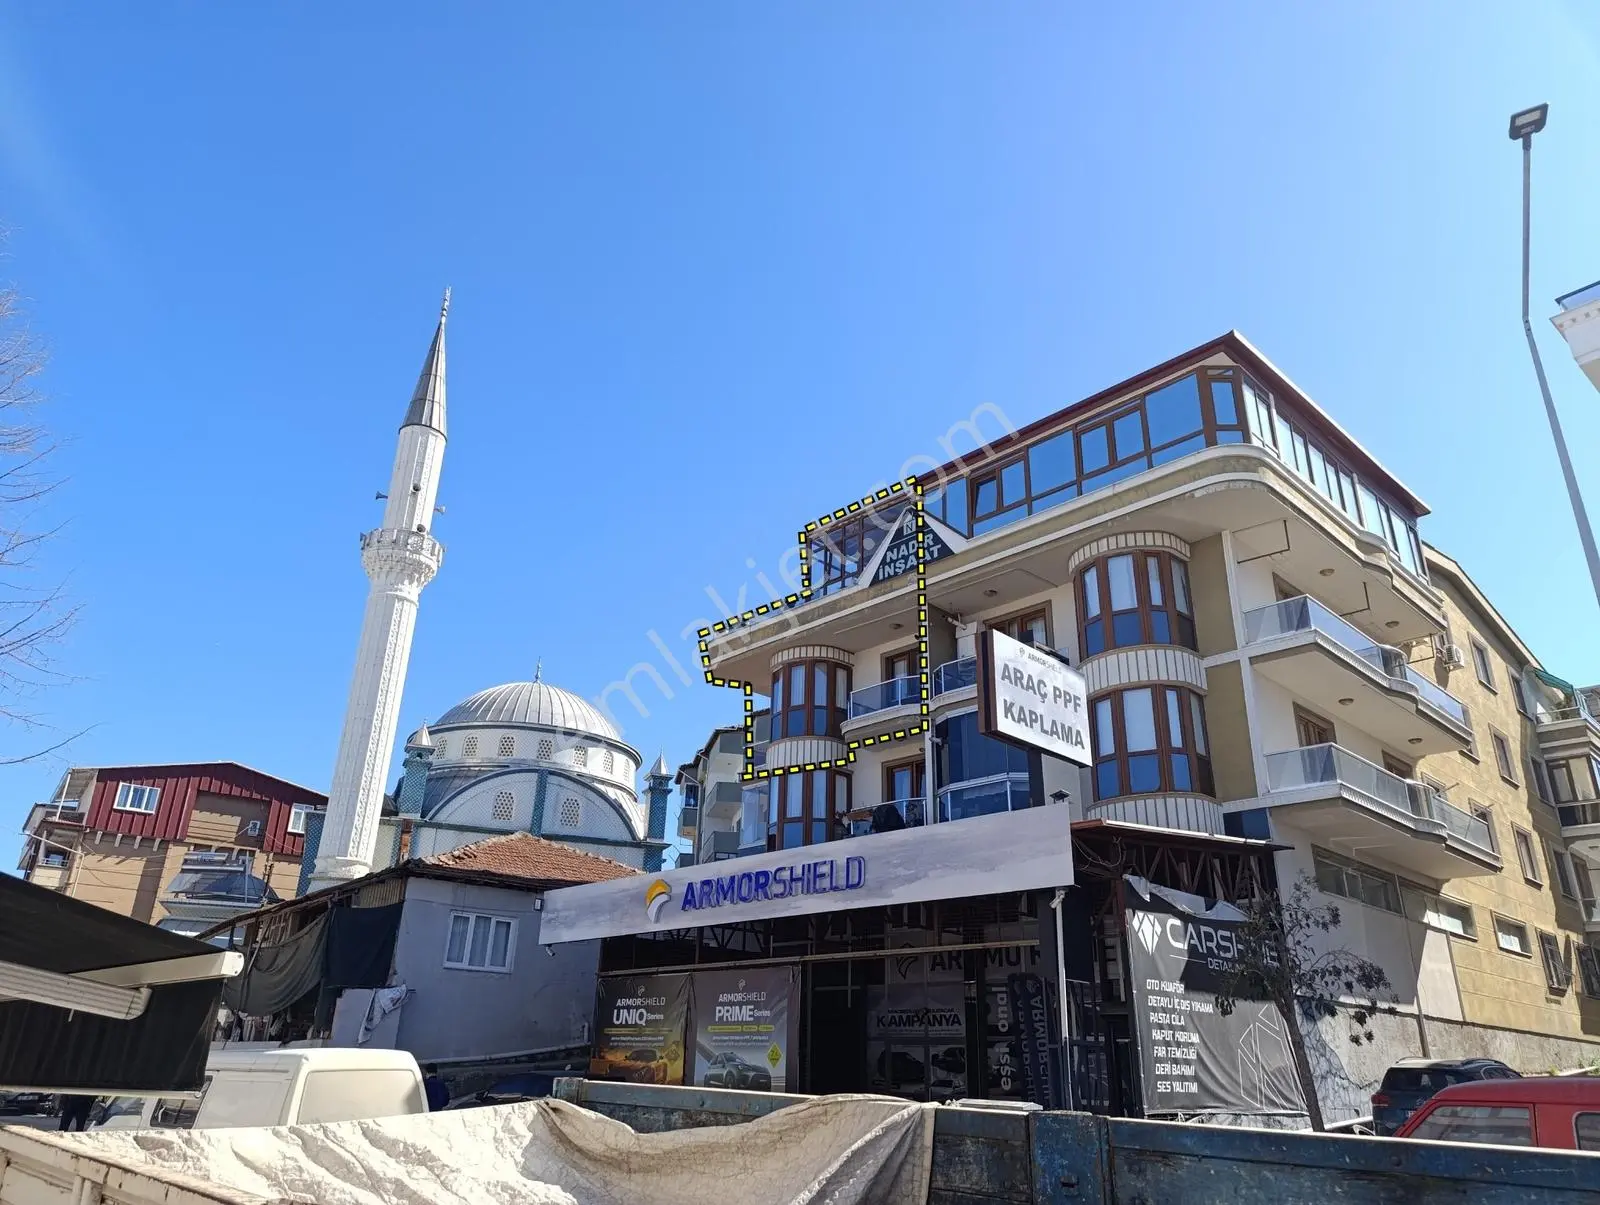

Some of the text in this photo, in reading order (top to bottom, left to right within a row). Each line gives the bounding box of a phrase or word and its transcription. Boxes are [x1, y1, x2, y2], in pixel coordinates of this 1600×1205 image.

[886, 533, 935, 563] NADR
[1001, 663, 1081, 713] ARAÇ PPF
[1003, 698, 1085, 750] KAPLAMA
[681, 855, 866, 912] ARMORSHIELD
[1166, 918, 1279, 968] CARSHE
[1146, 979, 1160, 990] OTO
[616, 997, 666, 1007] ARMORSHIELD
[718, 991, 767, 1002] ARMORSHIELD
[1148, 995, 1173, 1008] DETAYLI
[1192, 1001, 1214, 1013] YIKAMA
[613, 1008, 647, 1026] UNIQ
[715, 1005, 771, 1022] PRIME Series
[876, 1014, 963, 1028] KAMPANYA
[1150, 1012, 1170, 1024] PASTA
[1152, 1029, 1200, 1044] KAPUT KORUMA
[1154, 1046, 1166, 1057] FAR
[1156, 1061, 1195, 1076] DERİ BAKIMI
[1157, 1081, 1198, 1093] SES YALITIMI
